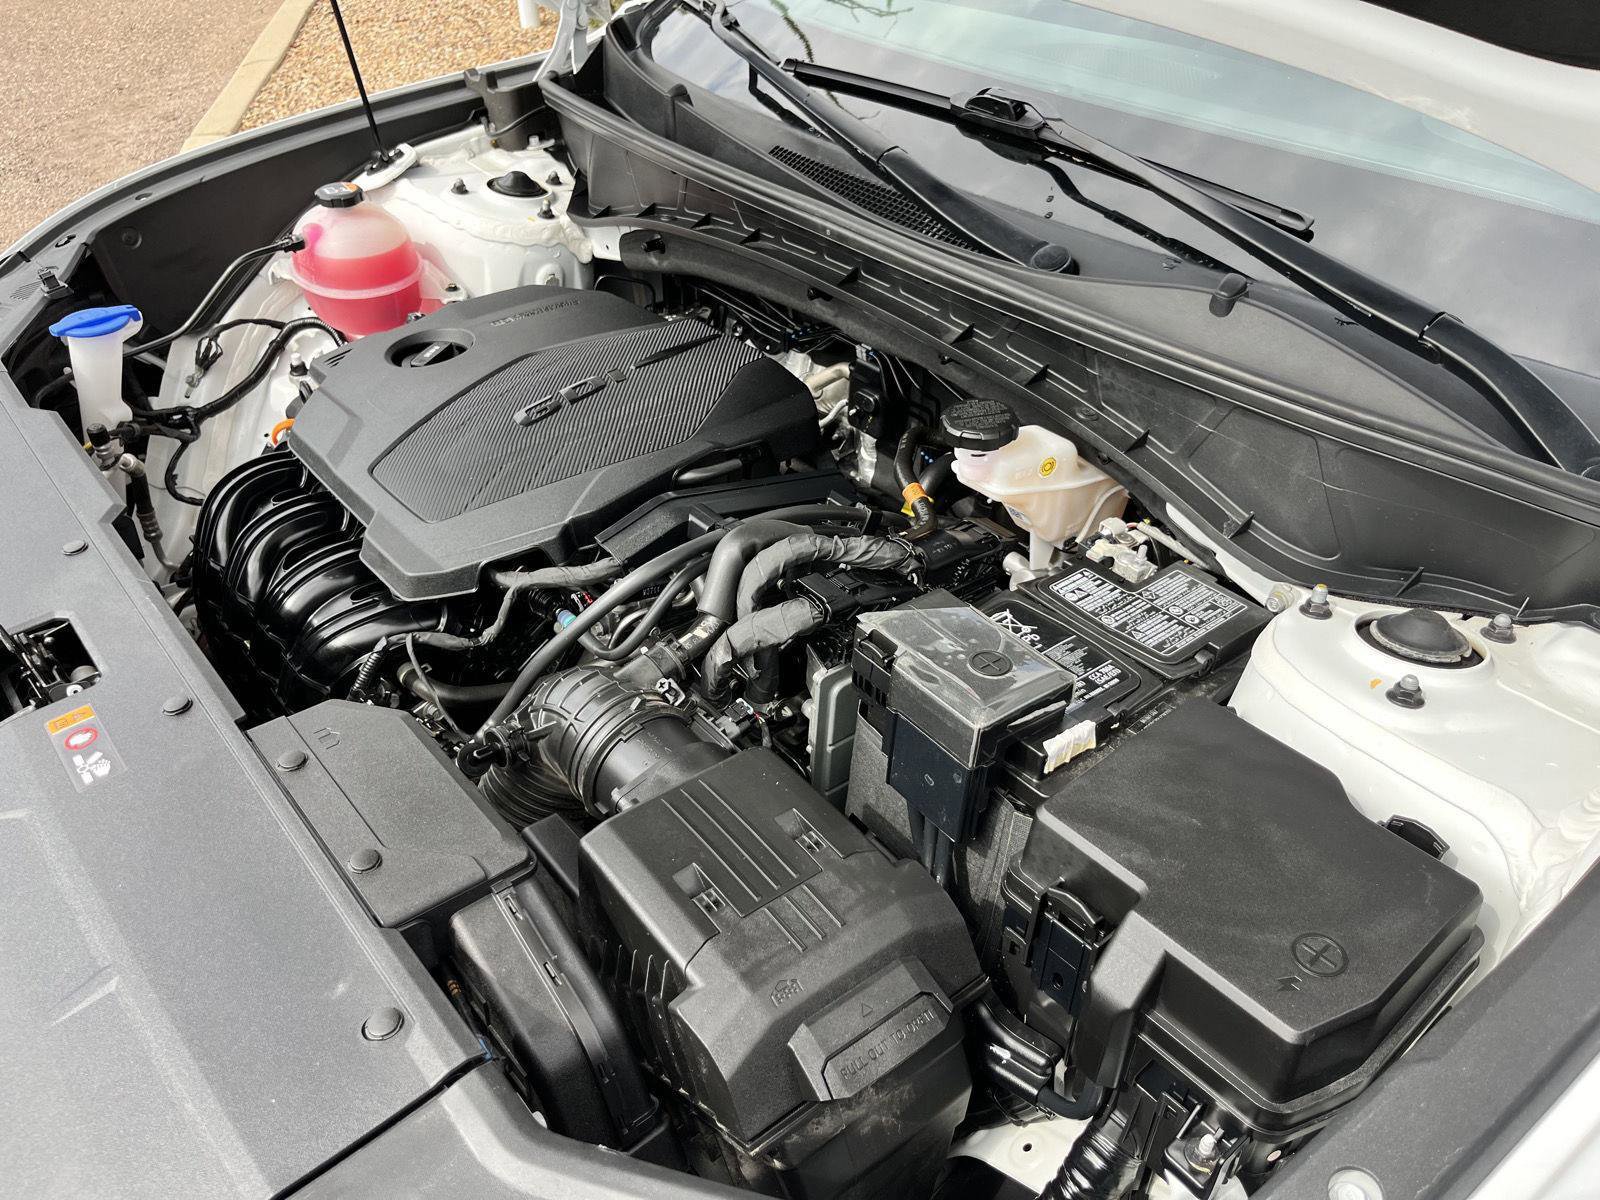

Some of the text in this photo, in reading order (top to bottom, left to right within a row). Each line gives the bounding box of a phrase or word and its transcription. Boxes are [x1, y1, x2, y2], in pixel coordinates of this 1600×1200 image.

[840, 1056, 869, 1080] PULL
[867, 1039, 890, 1061] OUT
[889, 1028, 906, 1044] TO
